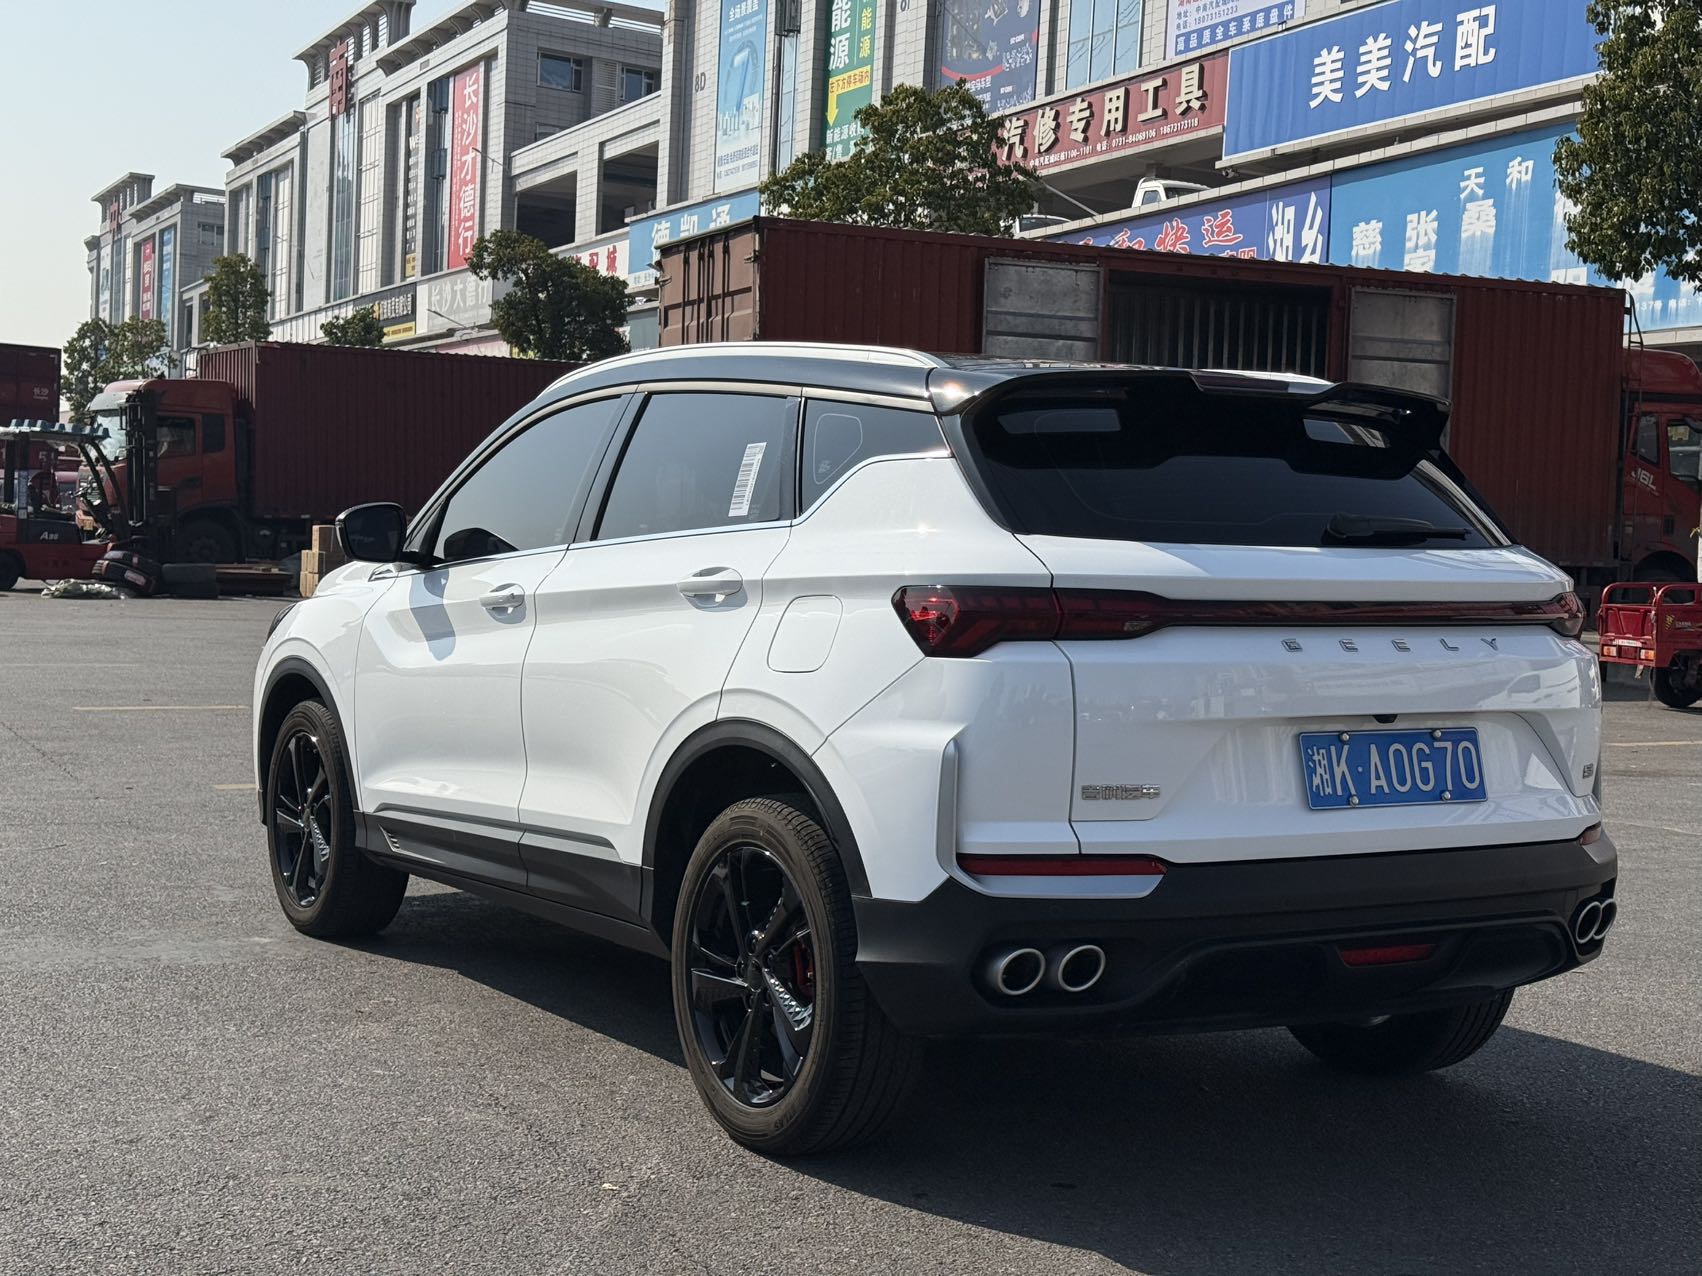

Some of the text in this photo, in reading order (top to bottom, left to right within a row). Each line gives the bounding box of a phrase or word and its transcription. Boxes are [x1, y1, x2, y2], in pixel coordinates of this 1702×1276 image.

[1176, 4, 1293, 52] 高品质全车系底盘件
[1308, 5, 1497, 110] 美美汽配
[1002, 62, 1204, 161] 汽修专用工具
[1281, 637, 1501, 653] GEELY
